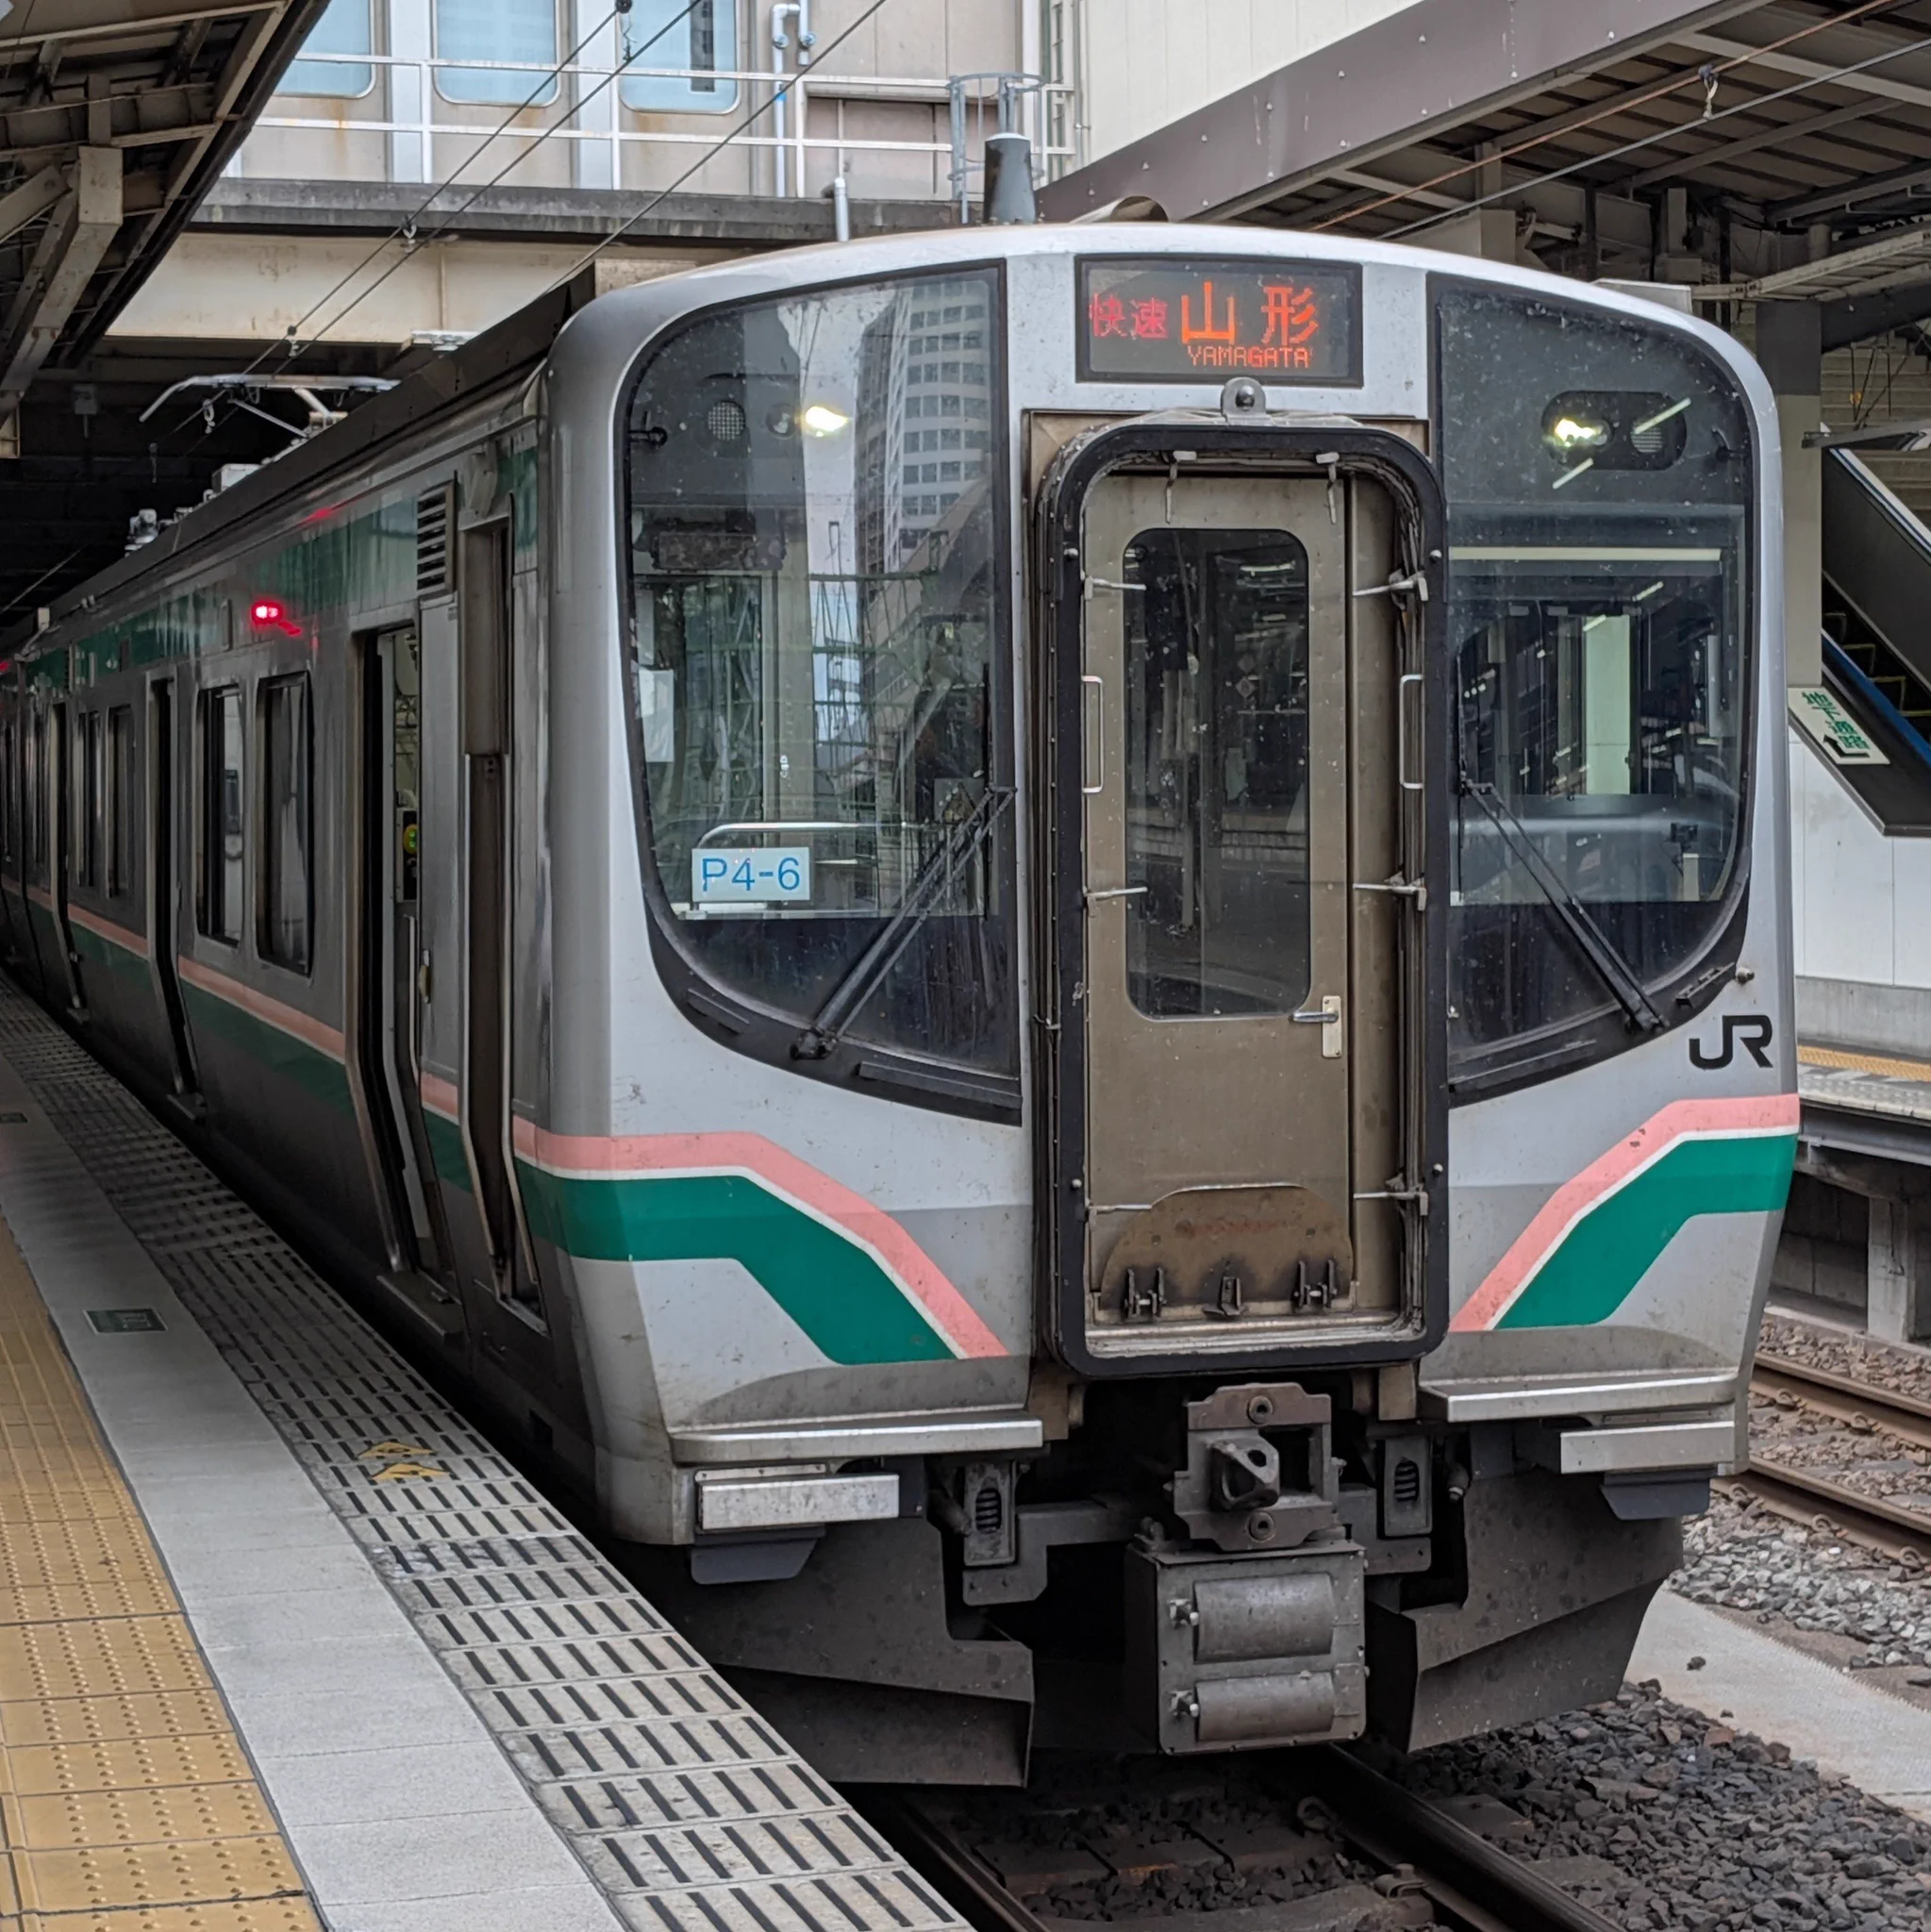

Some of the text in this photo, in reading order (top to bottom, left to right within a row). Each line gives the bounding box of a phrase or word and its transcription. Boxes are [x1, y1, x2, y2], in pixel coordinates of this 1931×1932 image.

[1089, 280, 1320, 345] 快速 山形
[1187, 346, 1311, 369] YAMAGATA
[1801, 691, 1871, 750] 地下通路
[701, 857, 800, 892] P4-6
[1689, 1015, 1774, 1070] JR
